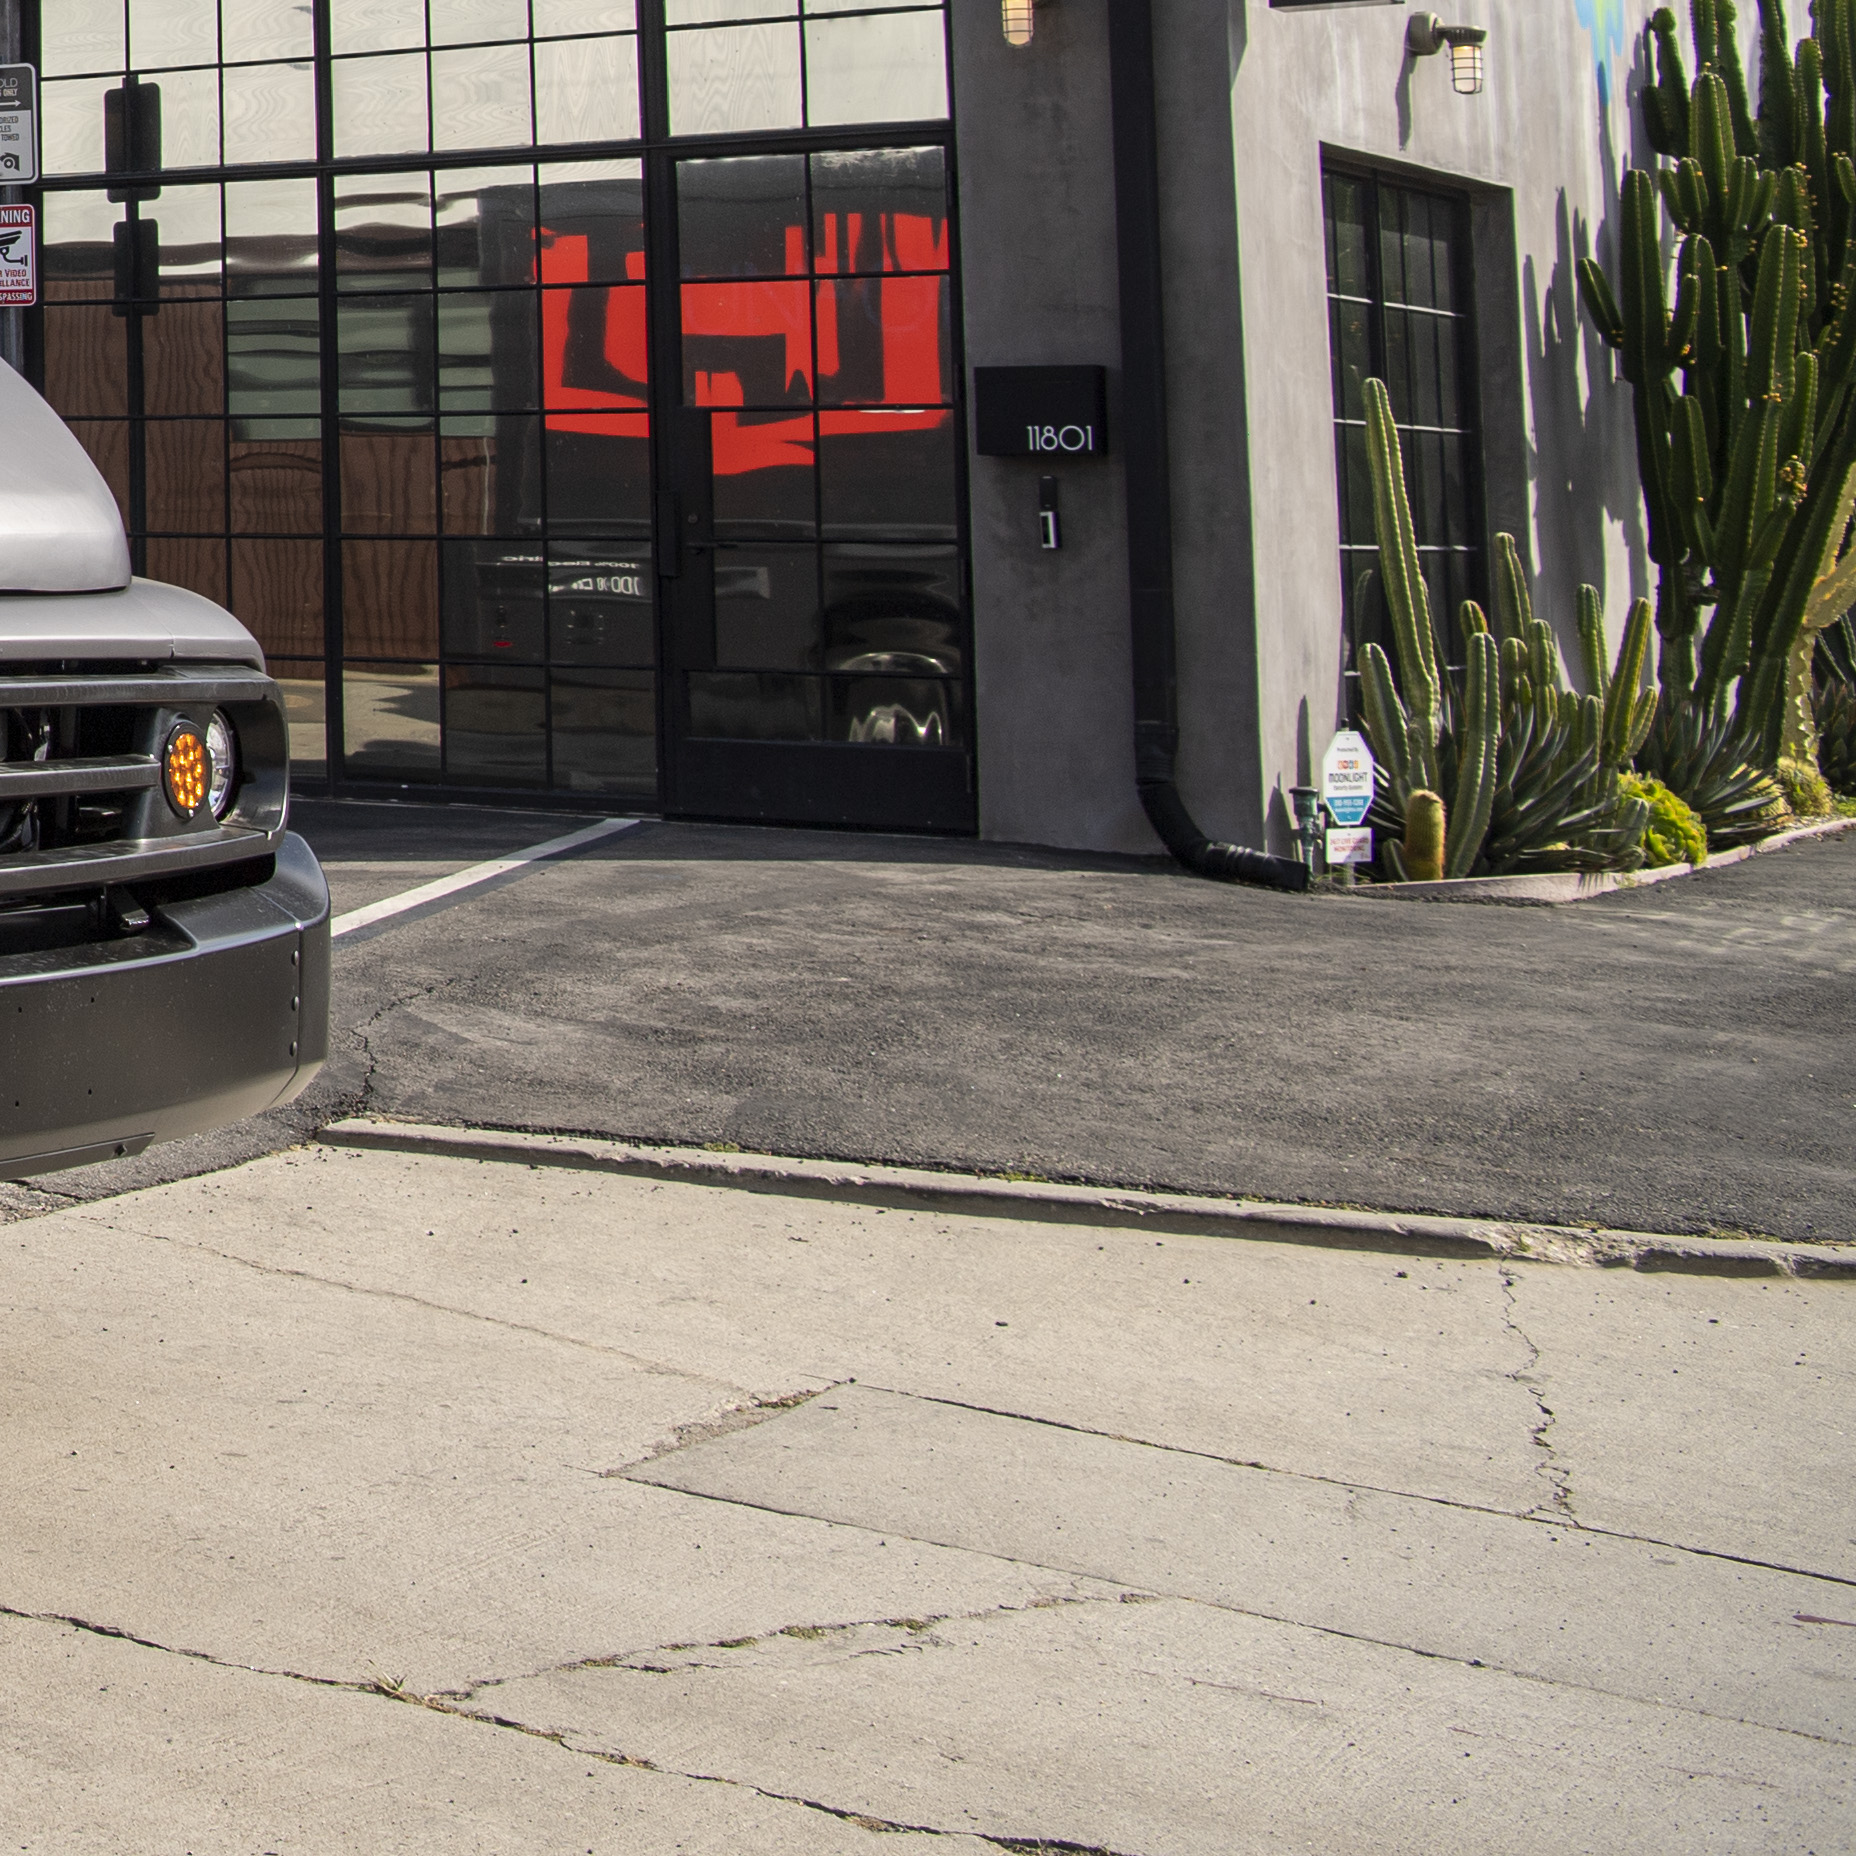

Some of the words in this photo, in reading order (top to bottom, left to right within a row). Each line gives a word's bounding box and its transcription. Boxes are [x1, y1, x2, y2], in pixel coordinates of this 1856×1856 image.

[3, 88, 18, 97] ONLY
[1, 133, 20, 142] TOWED
[4, 268, 27, 278] VIDEO
[1026, 425, 1093, 451] 11801
[1328, 771, 1368, 783] MOONLIGHT
